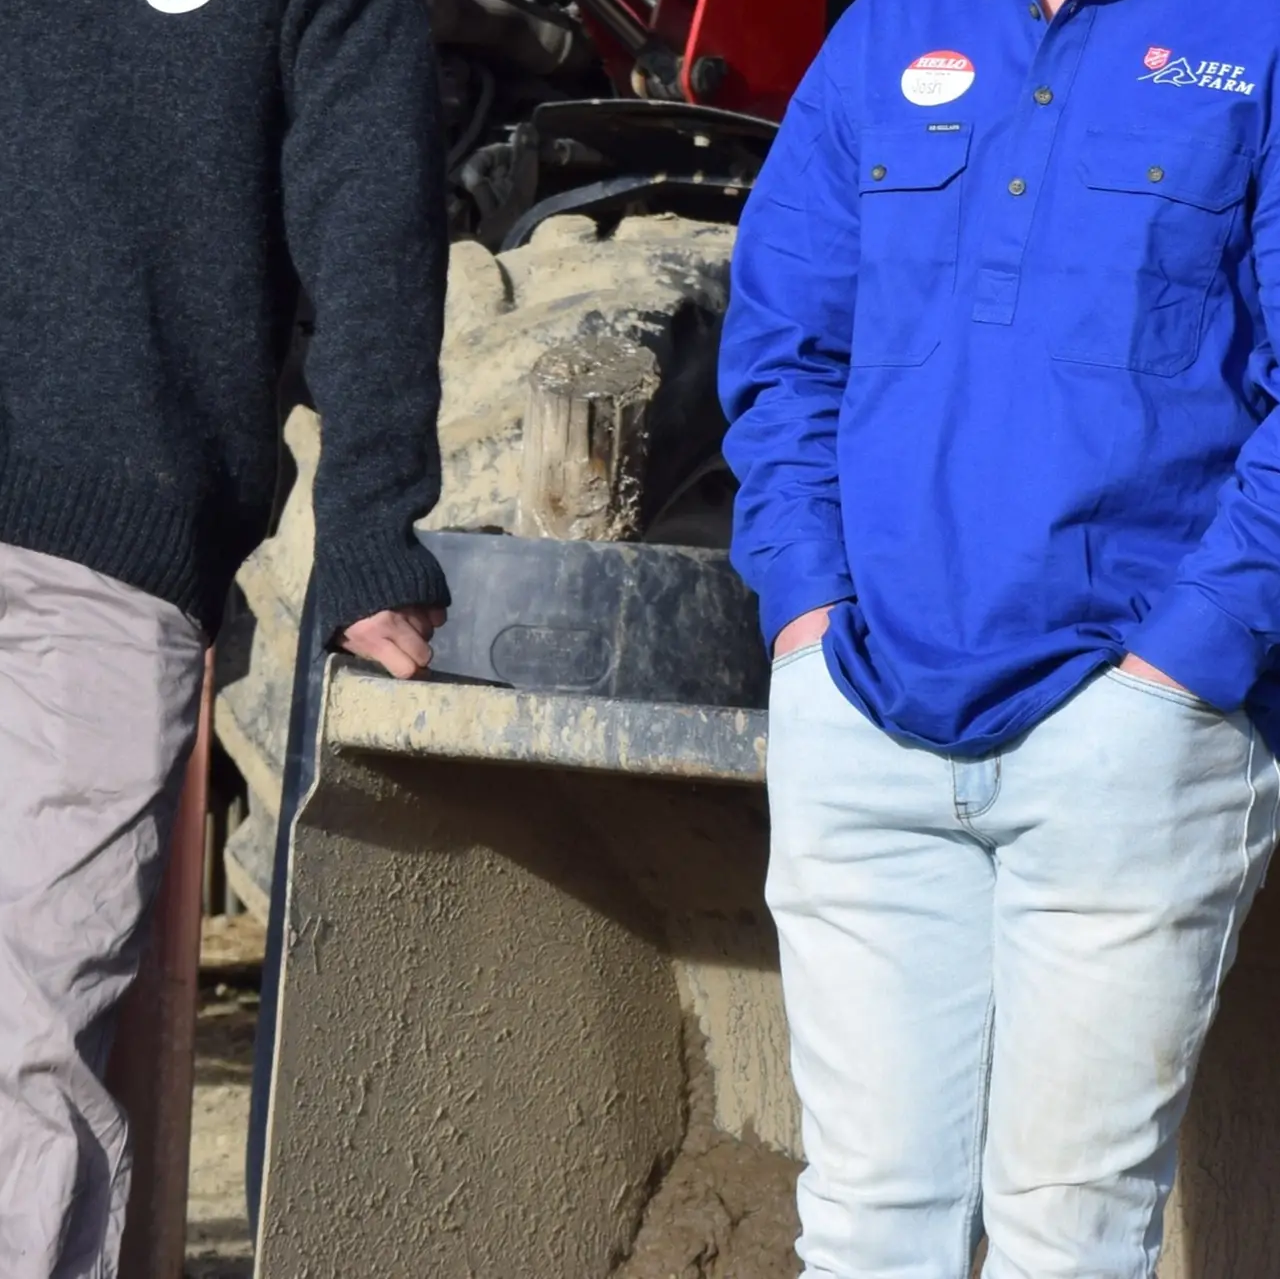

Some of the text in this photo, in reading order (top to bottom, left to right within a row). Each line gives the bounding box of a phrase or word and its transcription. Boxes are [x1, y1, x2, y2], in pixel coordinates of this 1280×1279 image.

[916, 57, 967, 69] HELLO
[1195, 60, 1246, 79] JEFF
[1197, 74, 1256, 96] FARM
